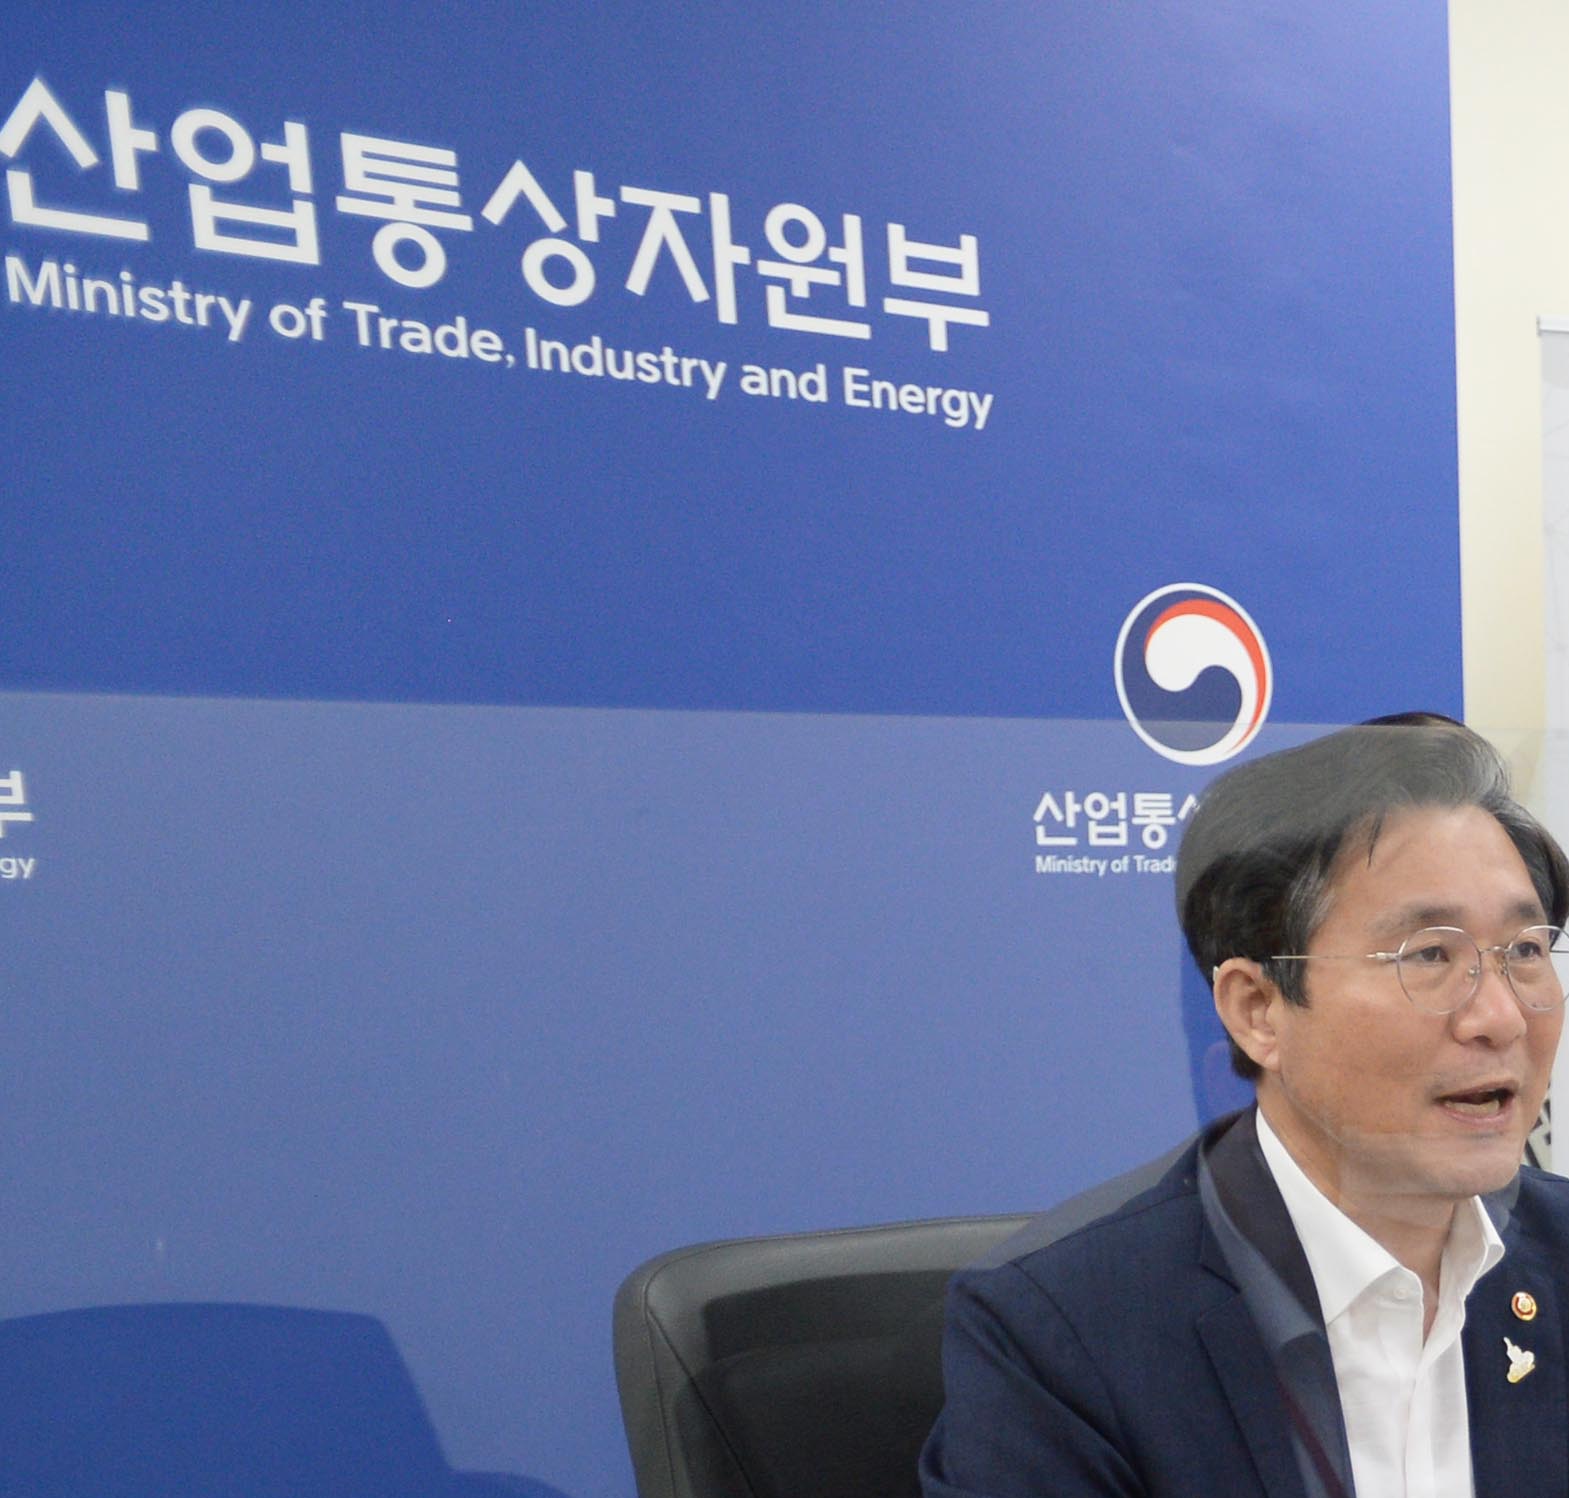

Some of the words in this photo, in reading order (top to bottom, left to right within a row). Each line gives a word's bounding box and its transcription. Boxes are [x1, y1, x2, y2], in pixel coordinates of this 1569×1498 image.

[0, 77, 991, 352] 산업통상자원부
[4, 255, 251, 342] Ministry
[269, 294, 329, 341] of
[343, 301, 515, 368] Trade,
[525, 326, 727, 400] Industry
[740, 358, 827, 402] and
[843, 367, 994, 430] Energy
[1035, 854, 1106, 877] Ministry
[1110, 854, 1130, 873] of
[1133, 854, 1177, 873] Trad
